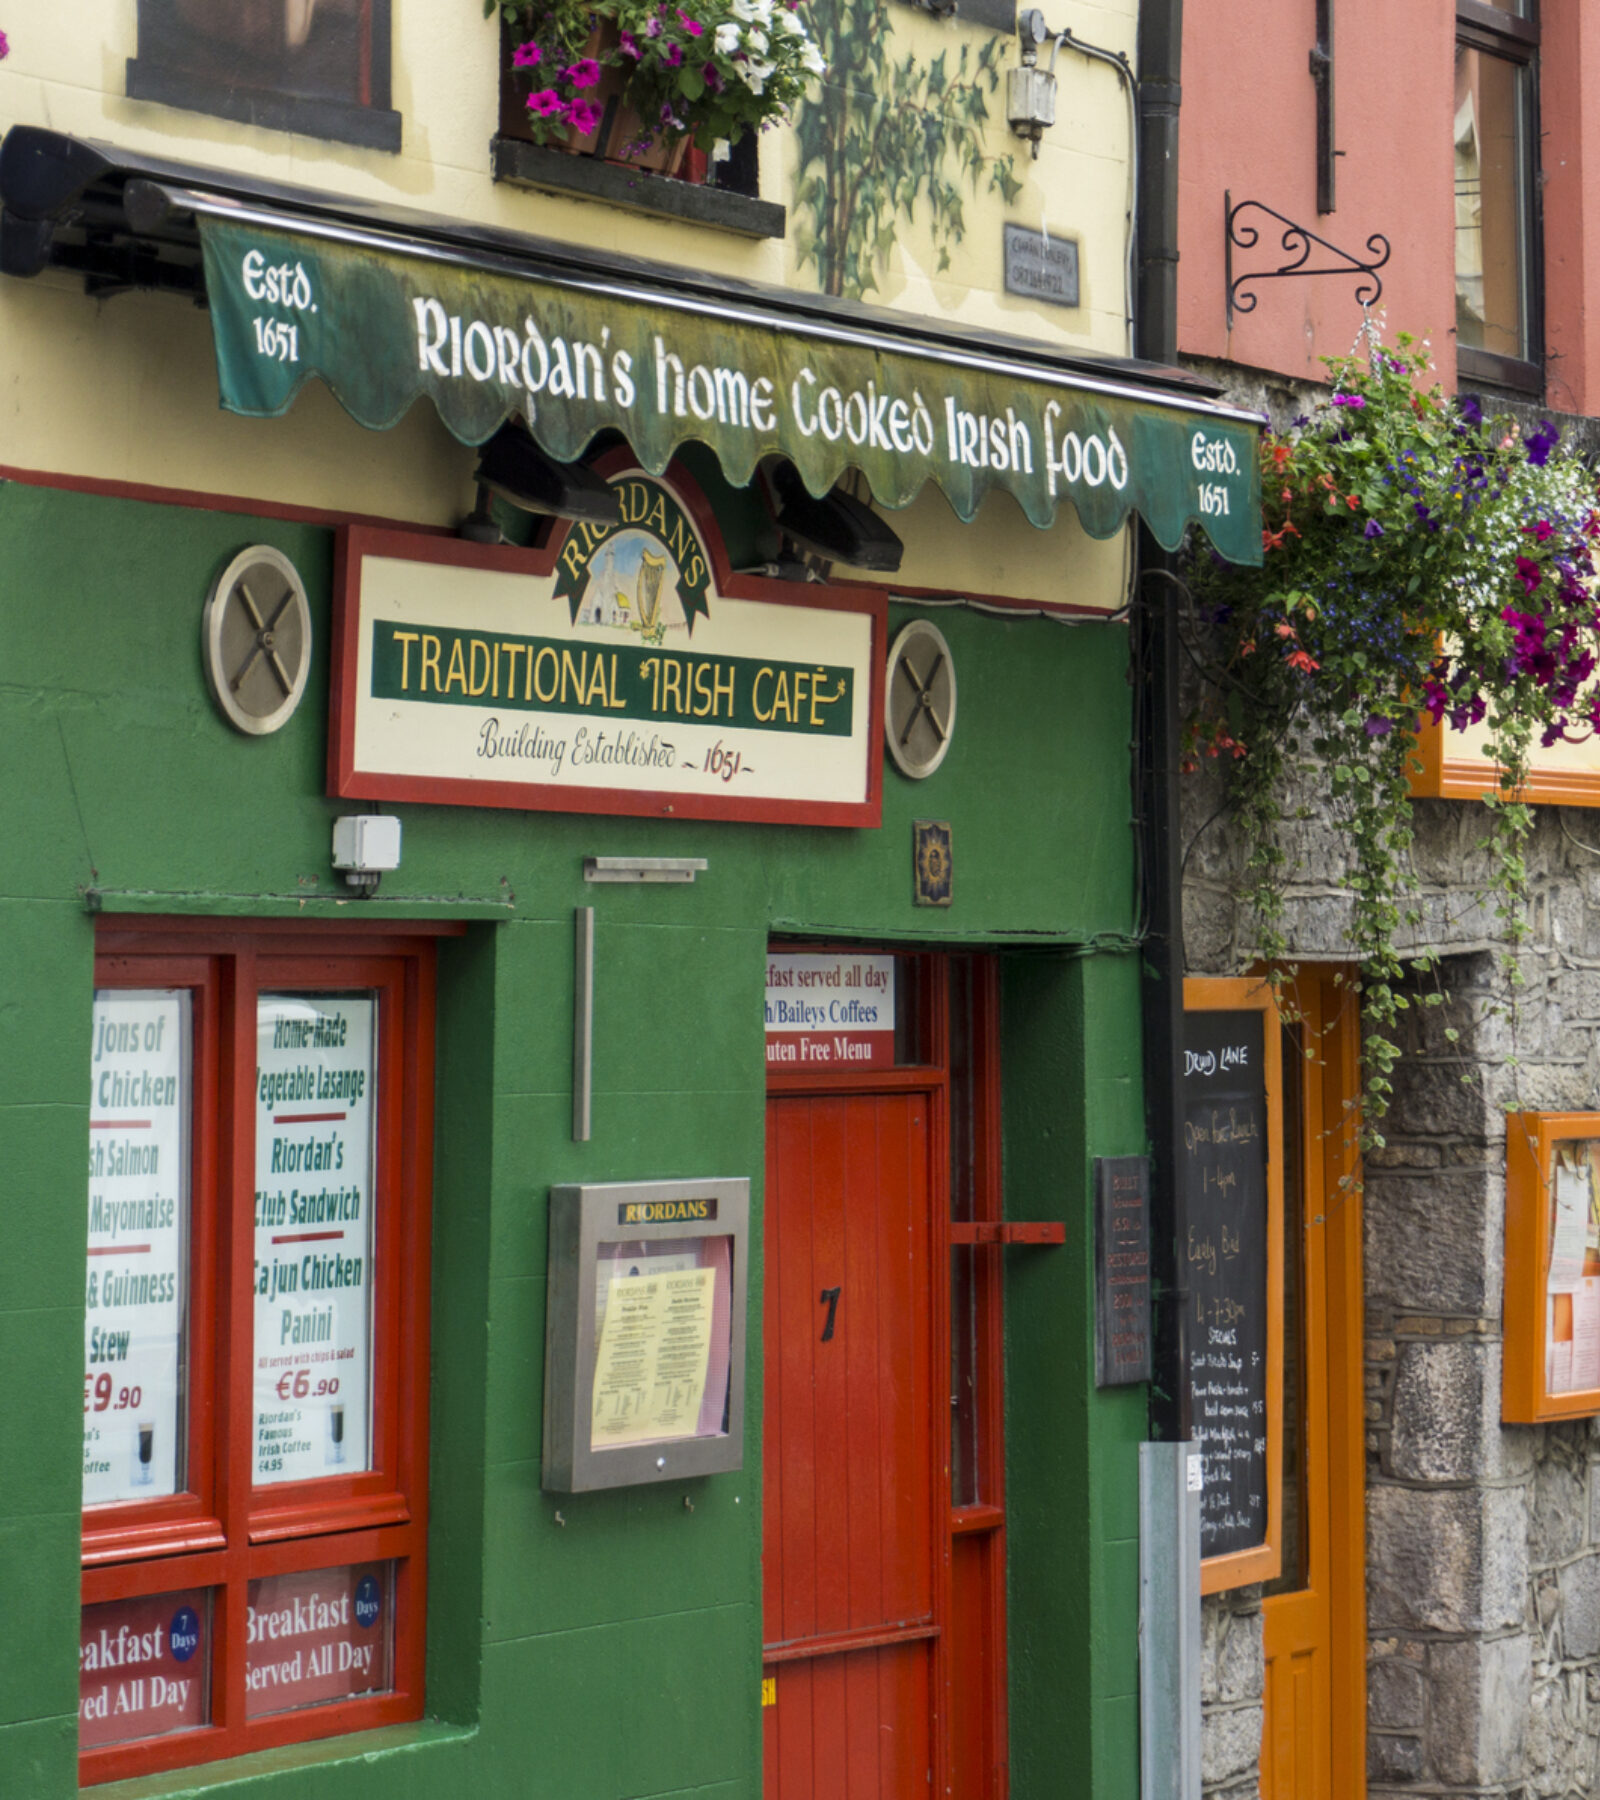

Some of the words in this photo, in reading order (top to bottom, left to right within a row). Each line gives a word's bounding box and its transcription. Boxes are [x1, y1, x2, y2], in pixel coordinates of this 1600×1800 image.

[242, 248, 318, 313] Estd.
[253, 317, 299, 362] 1651
[791, 367, 933, 456] Cooked
[945, 396, 1034, 476] Irish
[1191, 430, 1241, 477] Estd.
[1197, 483, 1231, 517] 1651
[392, 630, 627, 710] TRADITIONAL
[641, 656, 735, 718] IRISH
[476, 717, 566, 777] Building
[571, 725, 677, 770] Established
[798, 965, 840, 987] served
[845, 965, 861, 987] all
[865, 965, 888, 993] day
[765, 1000, 825, 1029] h/Baileys
[829, 1000, 878, 1023] Coffees
[94, 1016, 139, 1062] jons
[144, 1015, 166, 1053] of
[766, 1041, 796, 1061] uten
[800, 1038, 830, 1061] Free
[834, 1037, 872, 1061] Menu
[1220, 1046, 1249, 1071] LANE
[99, 1071, 176, 1108] Chicken
[316, 1064, 365, 1109] Lasange
[106, 1140, 159, 1177] Salmon
[271, 1131, 344, 1174] Riordan's
[90, 1193, 174, 1239] Mayonnaise
[289, 1184, 361, 1226] Sandwich
[625, 1200, 708, 1223] RIORDANS
[1188, 1225, 1217, 1275] Early
[86, 1271, 99, 1310] &
[101, 1268, 175, 1309] Guinness
[301, 1252, 363, 1292] Chicken
[280, 1305, 333, 1346] Panini
[820, 1286, 841, 1342] 7
[89, 1326, 131, 1364] Stew
[270, 1354, 293, 1369] served
[336, 1347, 355, 1361] salad
[258, 1409, 302, 1425] Riordan's
[258, 1428, 293, 1441] Famous
[83, 1461, 111, 1474] offee
[258, 1443, 281, 1457] Irish
[282, 1440, 311, 1454] Coffee
[356, 1598, 379, 1617] Days
[364, 1583, 371, 1599] 7
[171, 1632, 197, 1651] Days
[181, 1614, 188, 1632] 7
[306, 1646, 333, 1680] All
[338, 1641, 374, 1676] Day
[114, 1679, 145, 1716] All
[150, 1675, 191, 1713] Day
